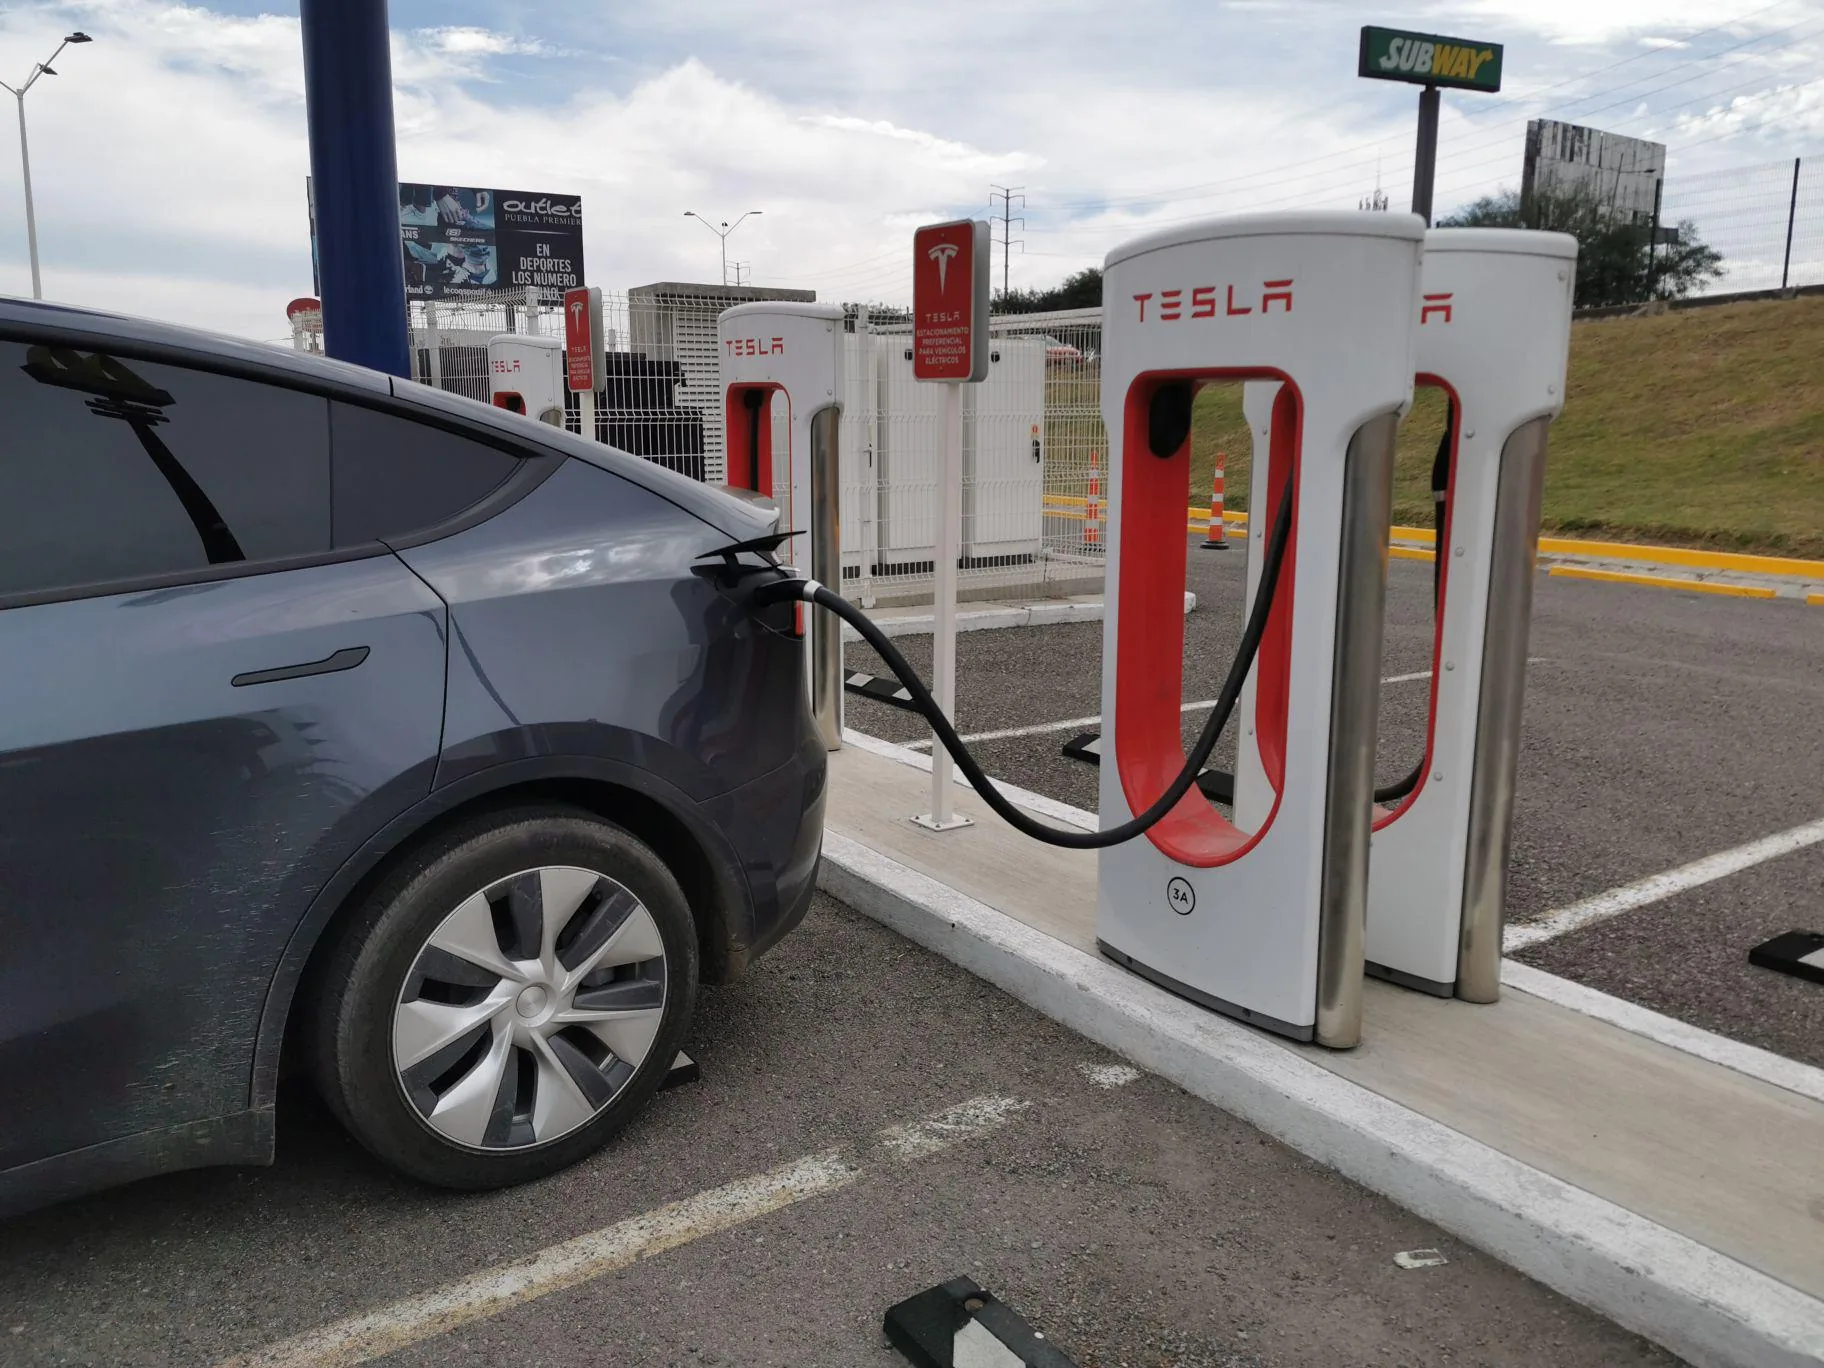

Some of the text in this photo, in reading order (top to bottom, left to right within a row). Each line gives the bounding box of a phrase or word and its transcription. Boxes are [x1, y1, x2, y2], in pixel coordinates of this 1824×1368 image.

[1379, 37, 1494, 79] SUBWAY
[502, 198, 582, 217] outlet
[504, 213, 582, 226] PUEBLA PREMIER
[400, 228, 419, 239] ANS
[536, 243, 550, 257] EN
[520, 256, 571, 272] DEPORTES
[512, 271, 531, 284] LOS
[1133, 279, 1293, 323] TESLA
[925, 312, 960, 322] TESLA
[726, 337, 783, 357] TESLA
[491, 360, 520, 374] TESLA
[1173, 888, 1188, 904] 3A
